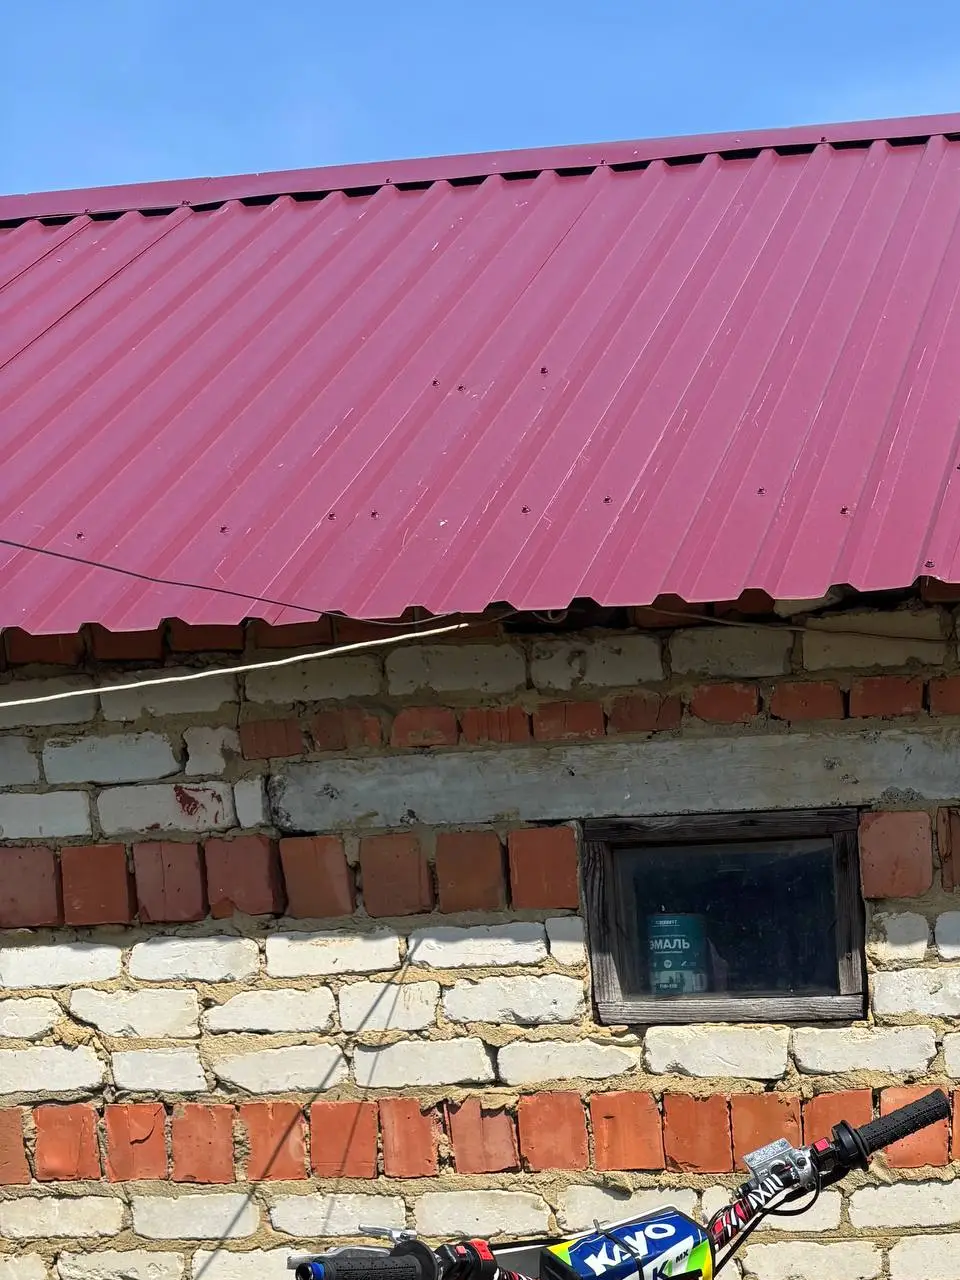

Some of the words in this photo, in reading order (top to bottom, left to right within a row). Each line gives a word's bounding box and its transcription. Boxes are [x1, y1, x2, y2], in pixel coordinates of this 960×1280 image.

[649, 938, 690, 950] ЭМАЛЬ
[584, 1223, 676, 1276] KAYO
[675, 1249, 689, 1264] MX
